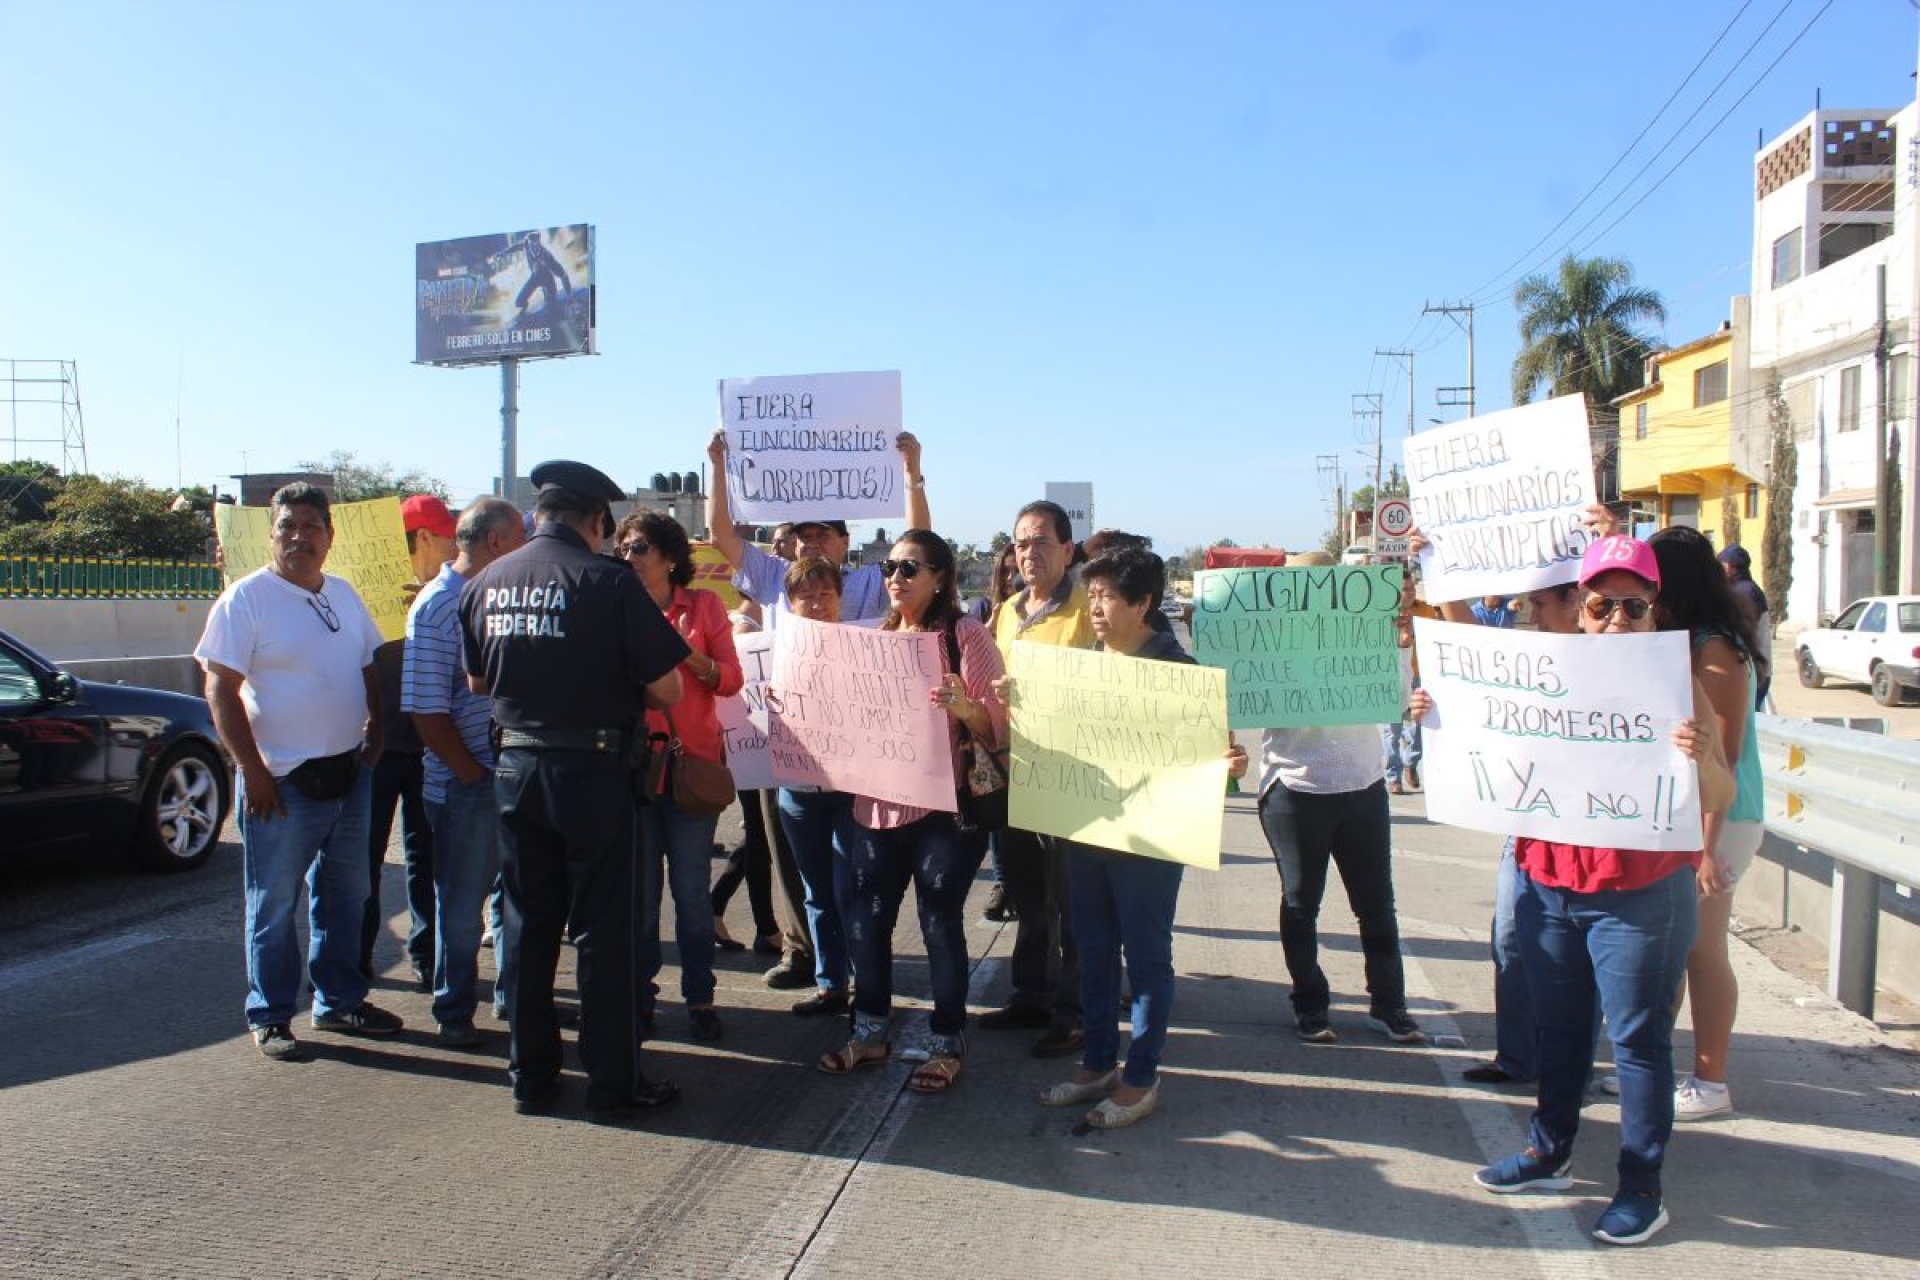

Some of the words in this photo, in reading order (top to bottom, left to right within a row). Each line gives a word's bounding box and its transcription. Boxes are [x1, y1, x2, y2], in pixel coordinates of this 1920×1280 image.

[525, 328, 551, 341] CINES
[737, 393, 814, 421] FUERA
[1389, 510, 1404, 524] 60
[1600, 538, 1632, 562] 25
[1200, 567, 1402, 614] EXIGIMOS
[486, 612, 565, 637] FEDERAL
[859, 632, 932, 677] MUERTE
[1231, 658, 1299, 684] CALLE
[1313, 654, 1398, 686] GLADIOLA
[1434, 641, 1568, 696] FALSAS
[1135, 661, 1222, 701] PRESENCIA
[819, 700, 843, 727] NO
[850, 704, 911, 736] CUMPLE
[1053, 684, 1133, 722] DIRECTOR
[1182, 701, 1218, 730] LA
[1482, 696, 1656, 742] PROMESAS
[1075, 722, 1198, 767] ARMANDO
